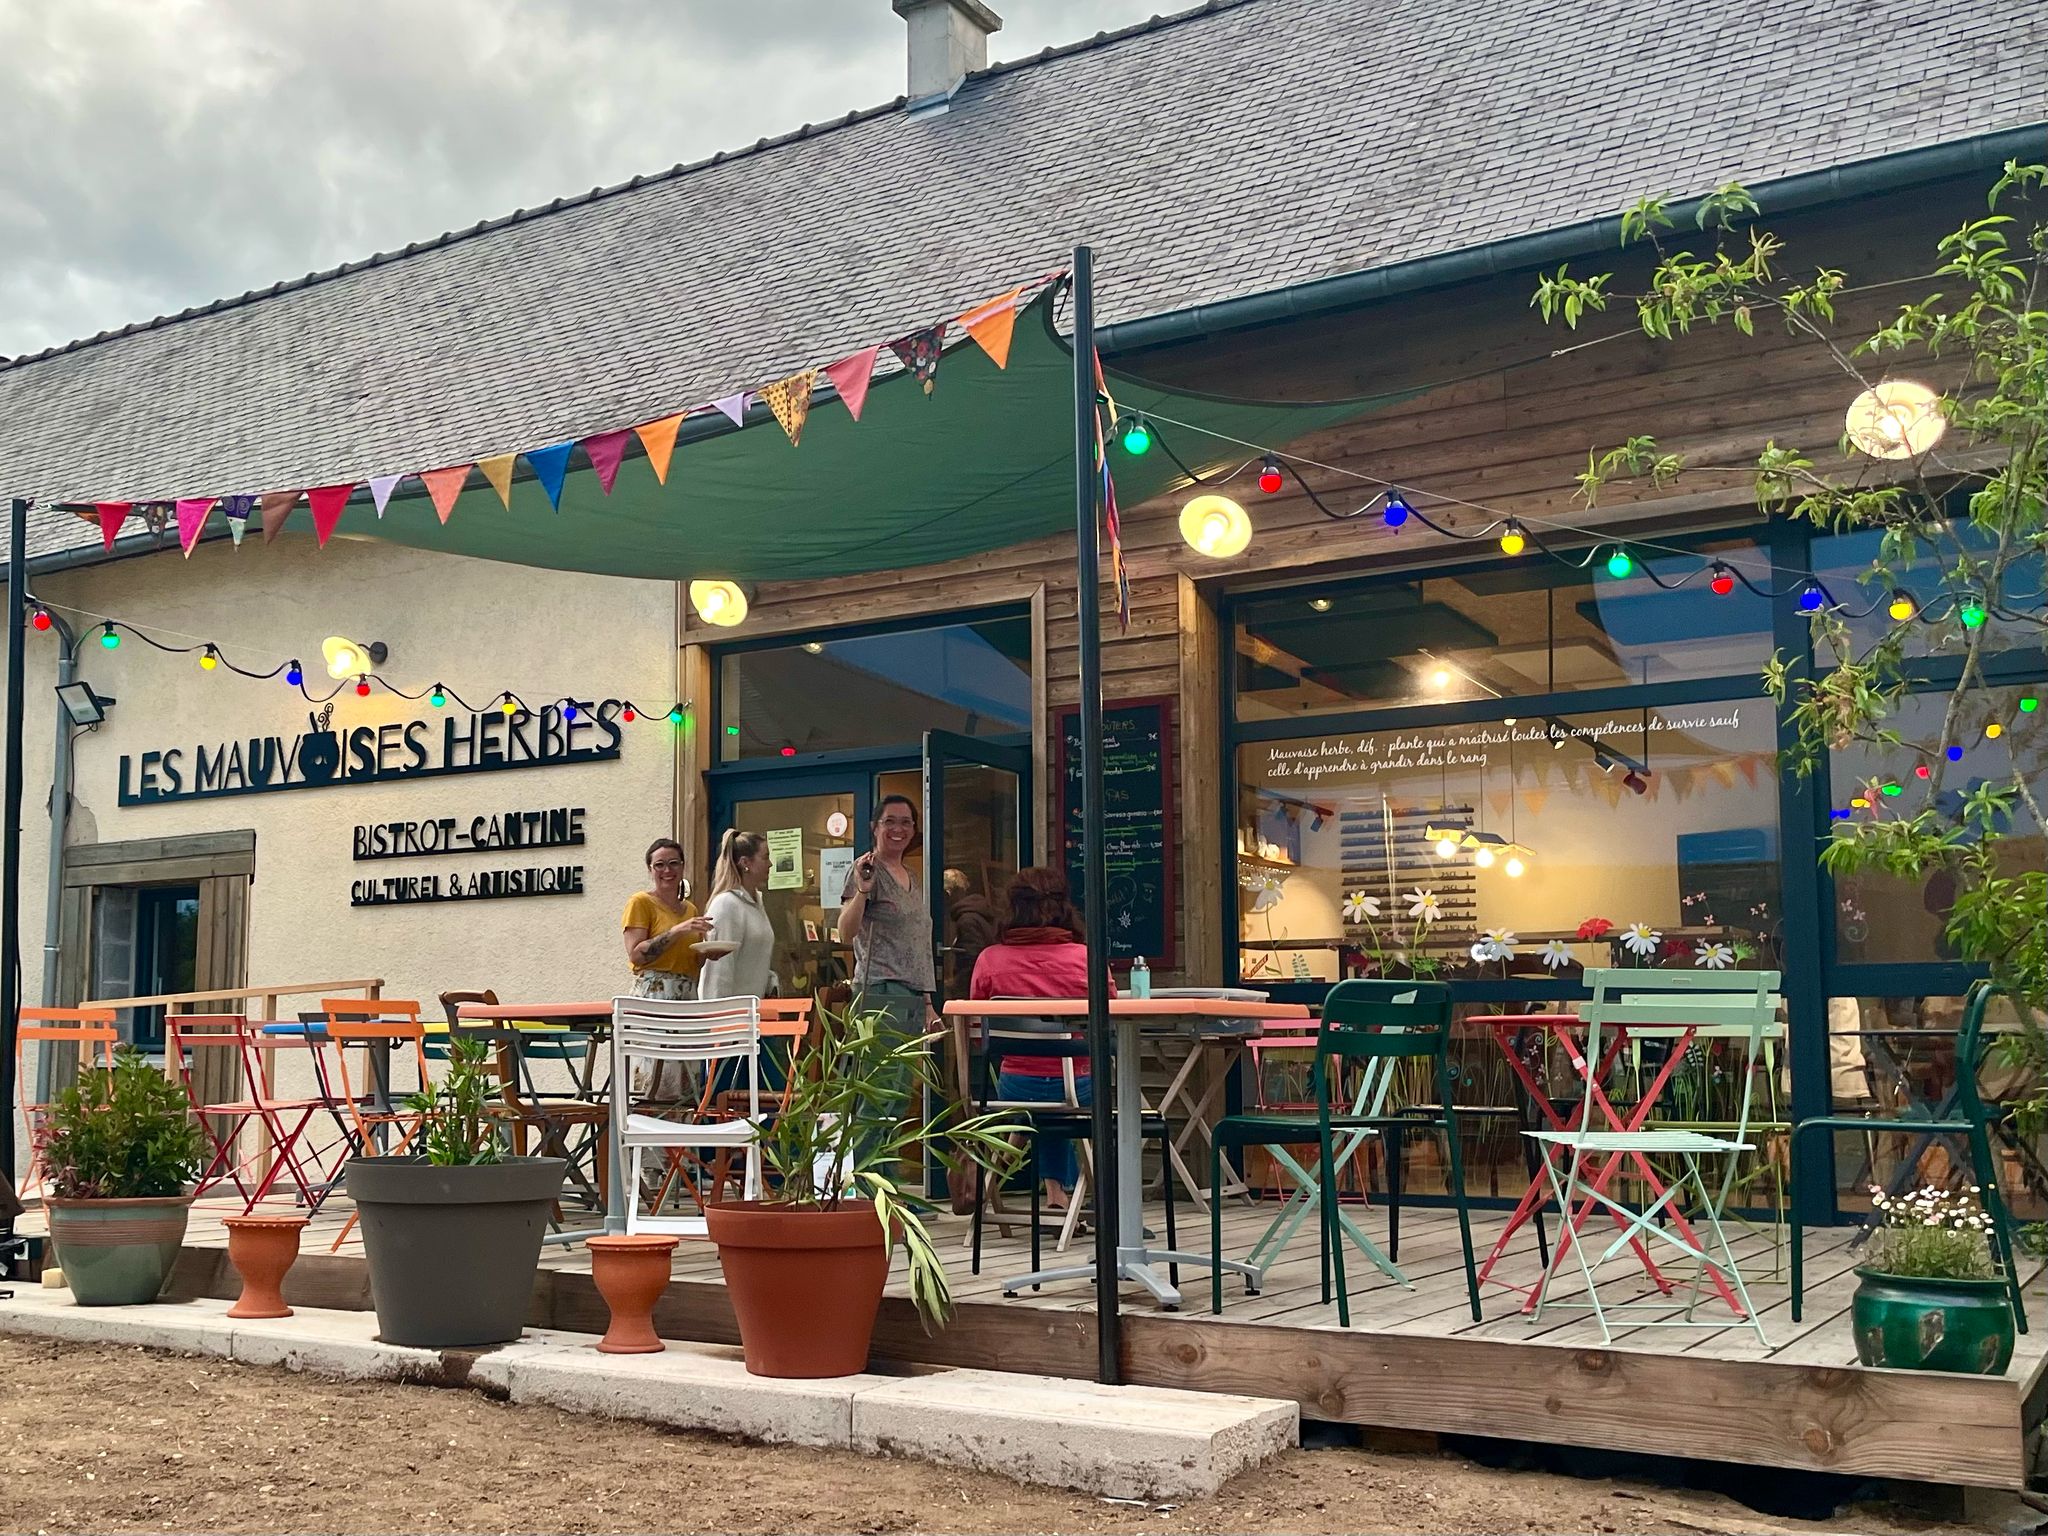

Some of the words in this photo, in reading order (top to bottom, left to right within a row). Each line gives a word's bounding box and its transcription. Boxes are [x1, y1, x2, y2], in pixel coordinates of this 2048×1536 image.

[117, 749, 182, 805] LES
[443, 698, 622, 771] HERBES
[1267, 747, 1319, 761] Mauvaise
[1321, 740, 1353, 758] herbe,
[1388, 736, 1425, 757] plante
[1426, 738, 1445, 754] qui
[1449, 739, 1456, 747] a
[1459, 730, 1510, 746] maîtrisé
[1512, 726, 1548, 742] toutes
[1550, 726, 1568, 740] les
[1570, 720, 1646, 743] compétences
[1649, 717, 1664, 731] de
[1667, 717, 1707, 729] survie
[1709, 709, 1739, 729] sauf
[1267, 763, 1291, 777] celle
[1293, 759, 1358, 780] d'apprendre
[1360, 759, 1368, 770] à
[1370, 754, 1414, 775] grandir
[1416, 753, 1445, 767] dans
[1447, 751, 1457, 765] le
[1460, 753, 1487, 769] rang
[353, 808, 586, 860] BISTROT-CANTINE
[351, 875, 445, 904] CULTUREL
[449, 873, 463, 898] &
[467, 866, 584, 899] ARTISTIQUE
